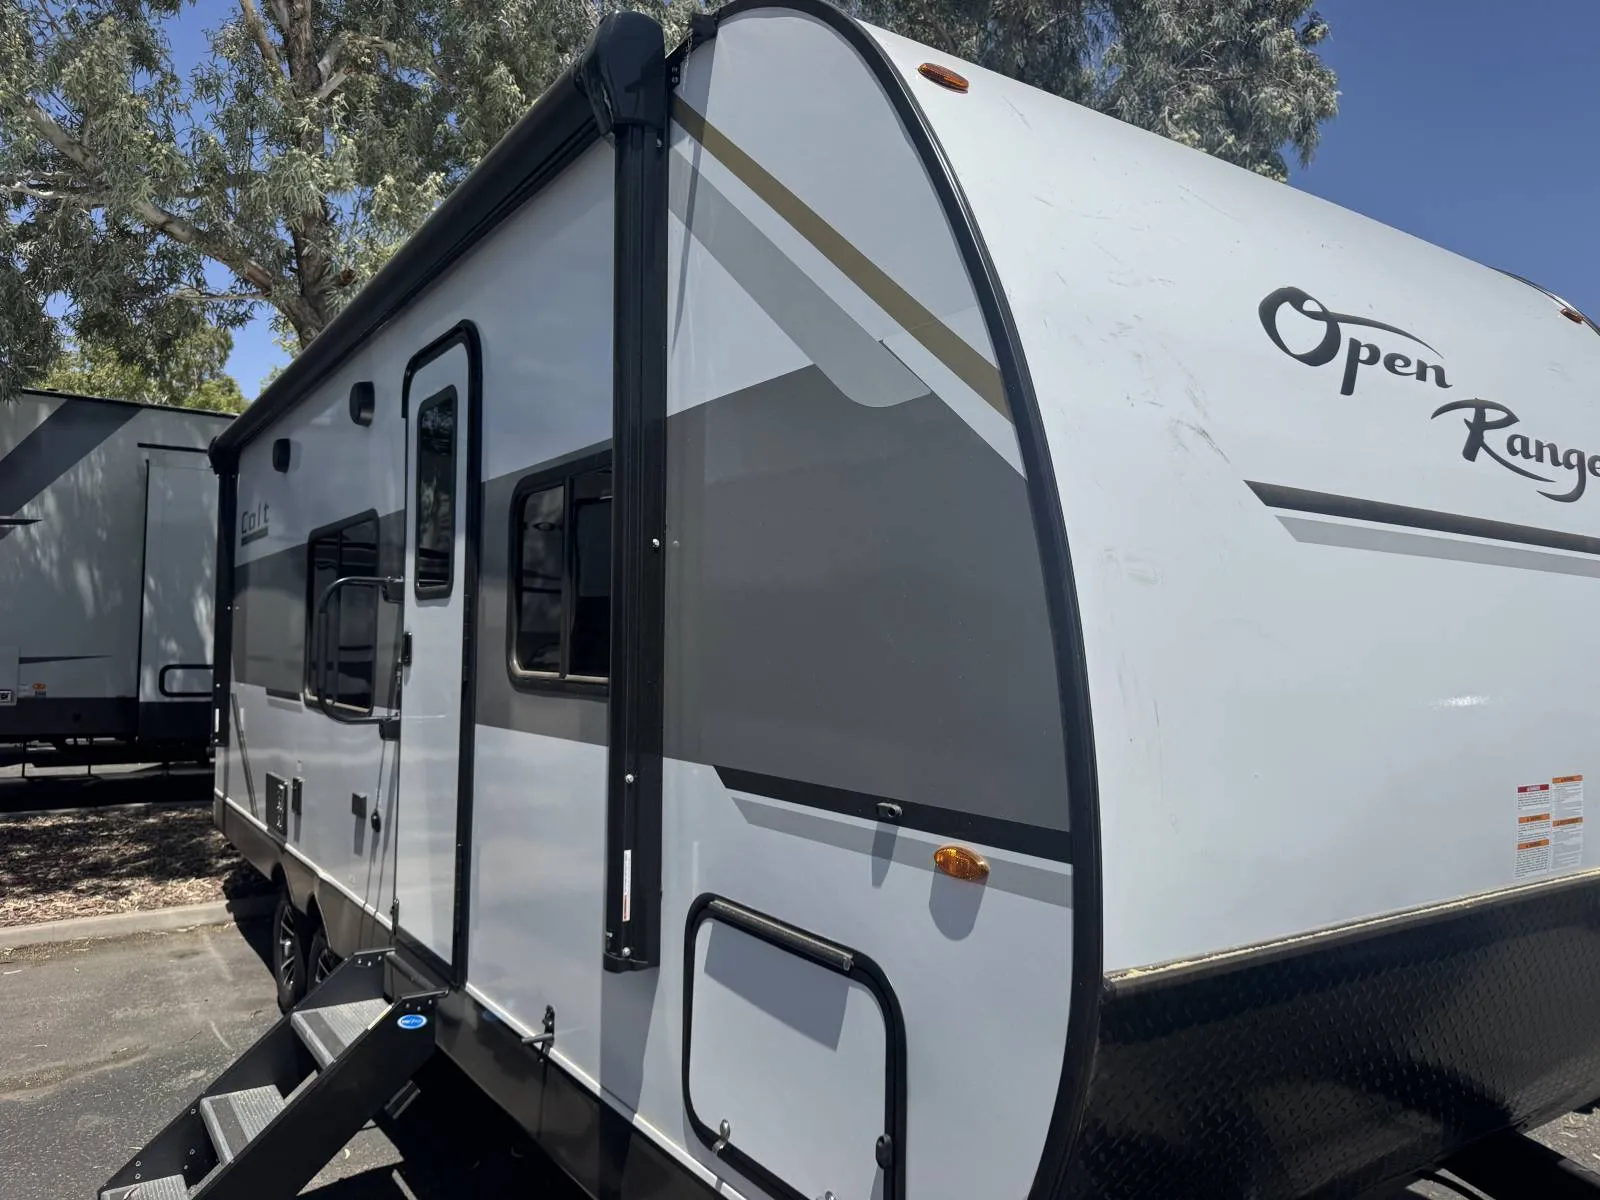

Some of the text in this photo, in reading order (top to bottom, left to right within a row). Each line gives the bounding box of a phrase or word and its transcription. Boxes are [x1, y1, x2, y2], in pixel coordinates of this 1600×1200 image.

[1258, 286, 1452, 396] Open
[1431, 398, 1600, 503] Range
[241, 502, 270, 534] Colt
